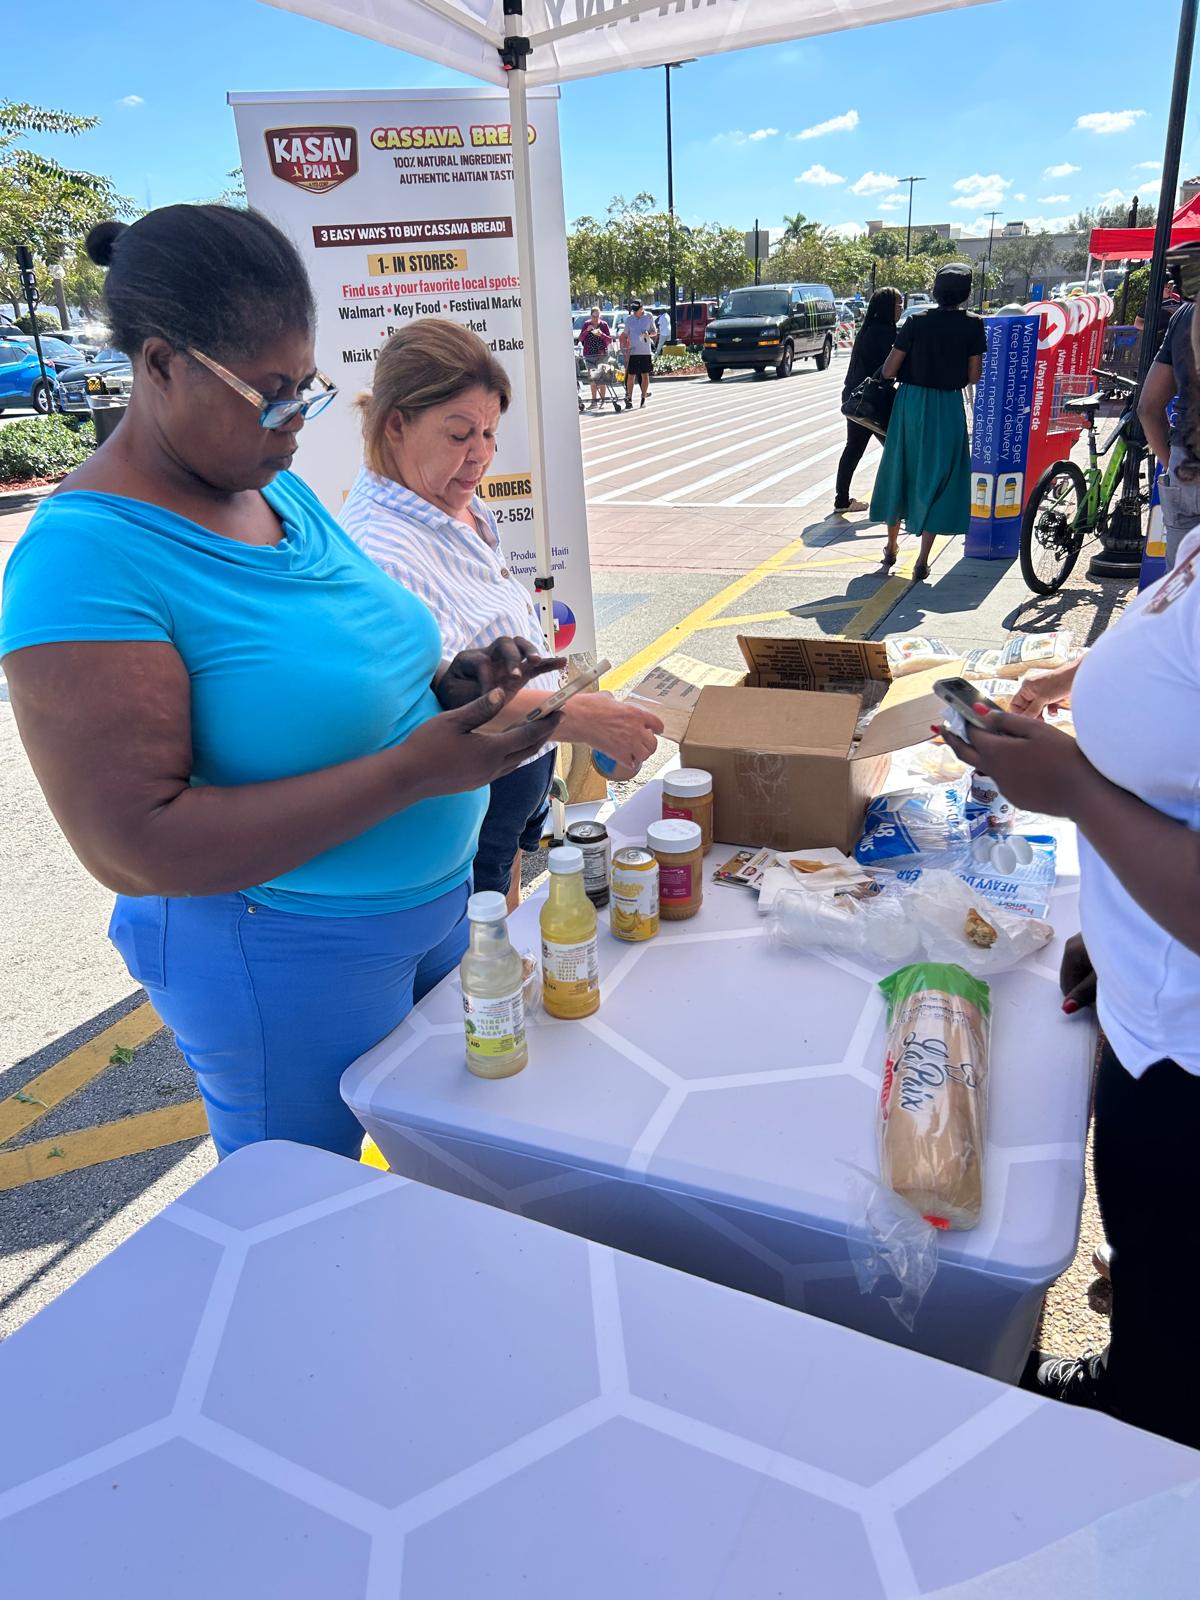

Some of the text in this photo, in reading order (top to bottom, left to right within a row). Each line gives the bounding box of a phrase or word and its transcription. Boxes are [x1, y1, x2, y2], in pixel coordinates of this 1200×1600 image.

[371, 126, 464, 150] CASSAVA
[273, 137, 352, 163] KASAV
[393, 153, 514, 169] 100% NATURAL INGREDIENT
[303, 164, 332, 179] PAM
[400, 172, 451, 185] AUTHENTIC
[452, 171, 488, 182] HAITIAN
[321, 221, 506, 242] 3 EASY WAYS TO BUY CASSAVA BREAD!
[377, 253, 458, 274] 1- IN STORES:
[342, 275, 520, 298] Find us at your favorite local spots:
[338, 305, 386, 320] Walmart
[394, 303, 414, 318] Key
[415, 301, 441, 315] Food
[450, 297, 490, 313] Festival
[499, 338, 524, 352] Bake
[342, 349, 372, 363] Mizik
[983, 325, 1003, 465] Walmart+ members get
[1000, 324, 1022, 460] free pharmacy delivery
[1012, 322, 1034, 464] Walmart+ members get
[1033, 390, 1044, 417] Miles
[1031, 417, 1041, 431] de
[972, 414, 985, 460] delivery
[488, 479, 532, 498] ORDERS
[551, 547, 569, 557] Haiti
[509, 564, 537, 577] Always
[875, 822, 896, 838] 48
[977, 878, 1019, 894] HEAVY
